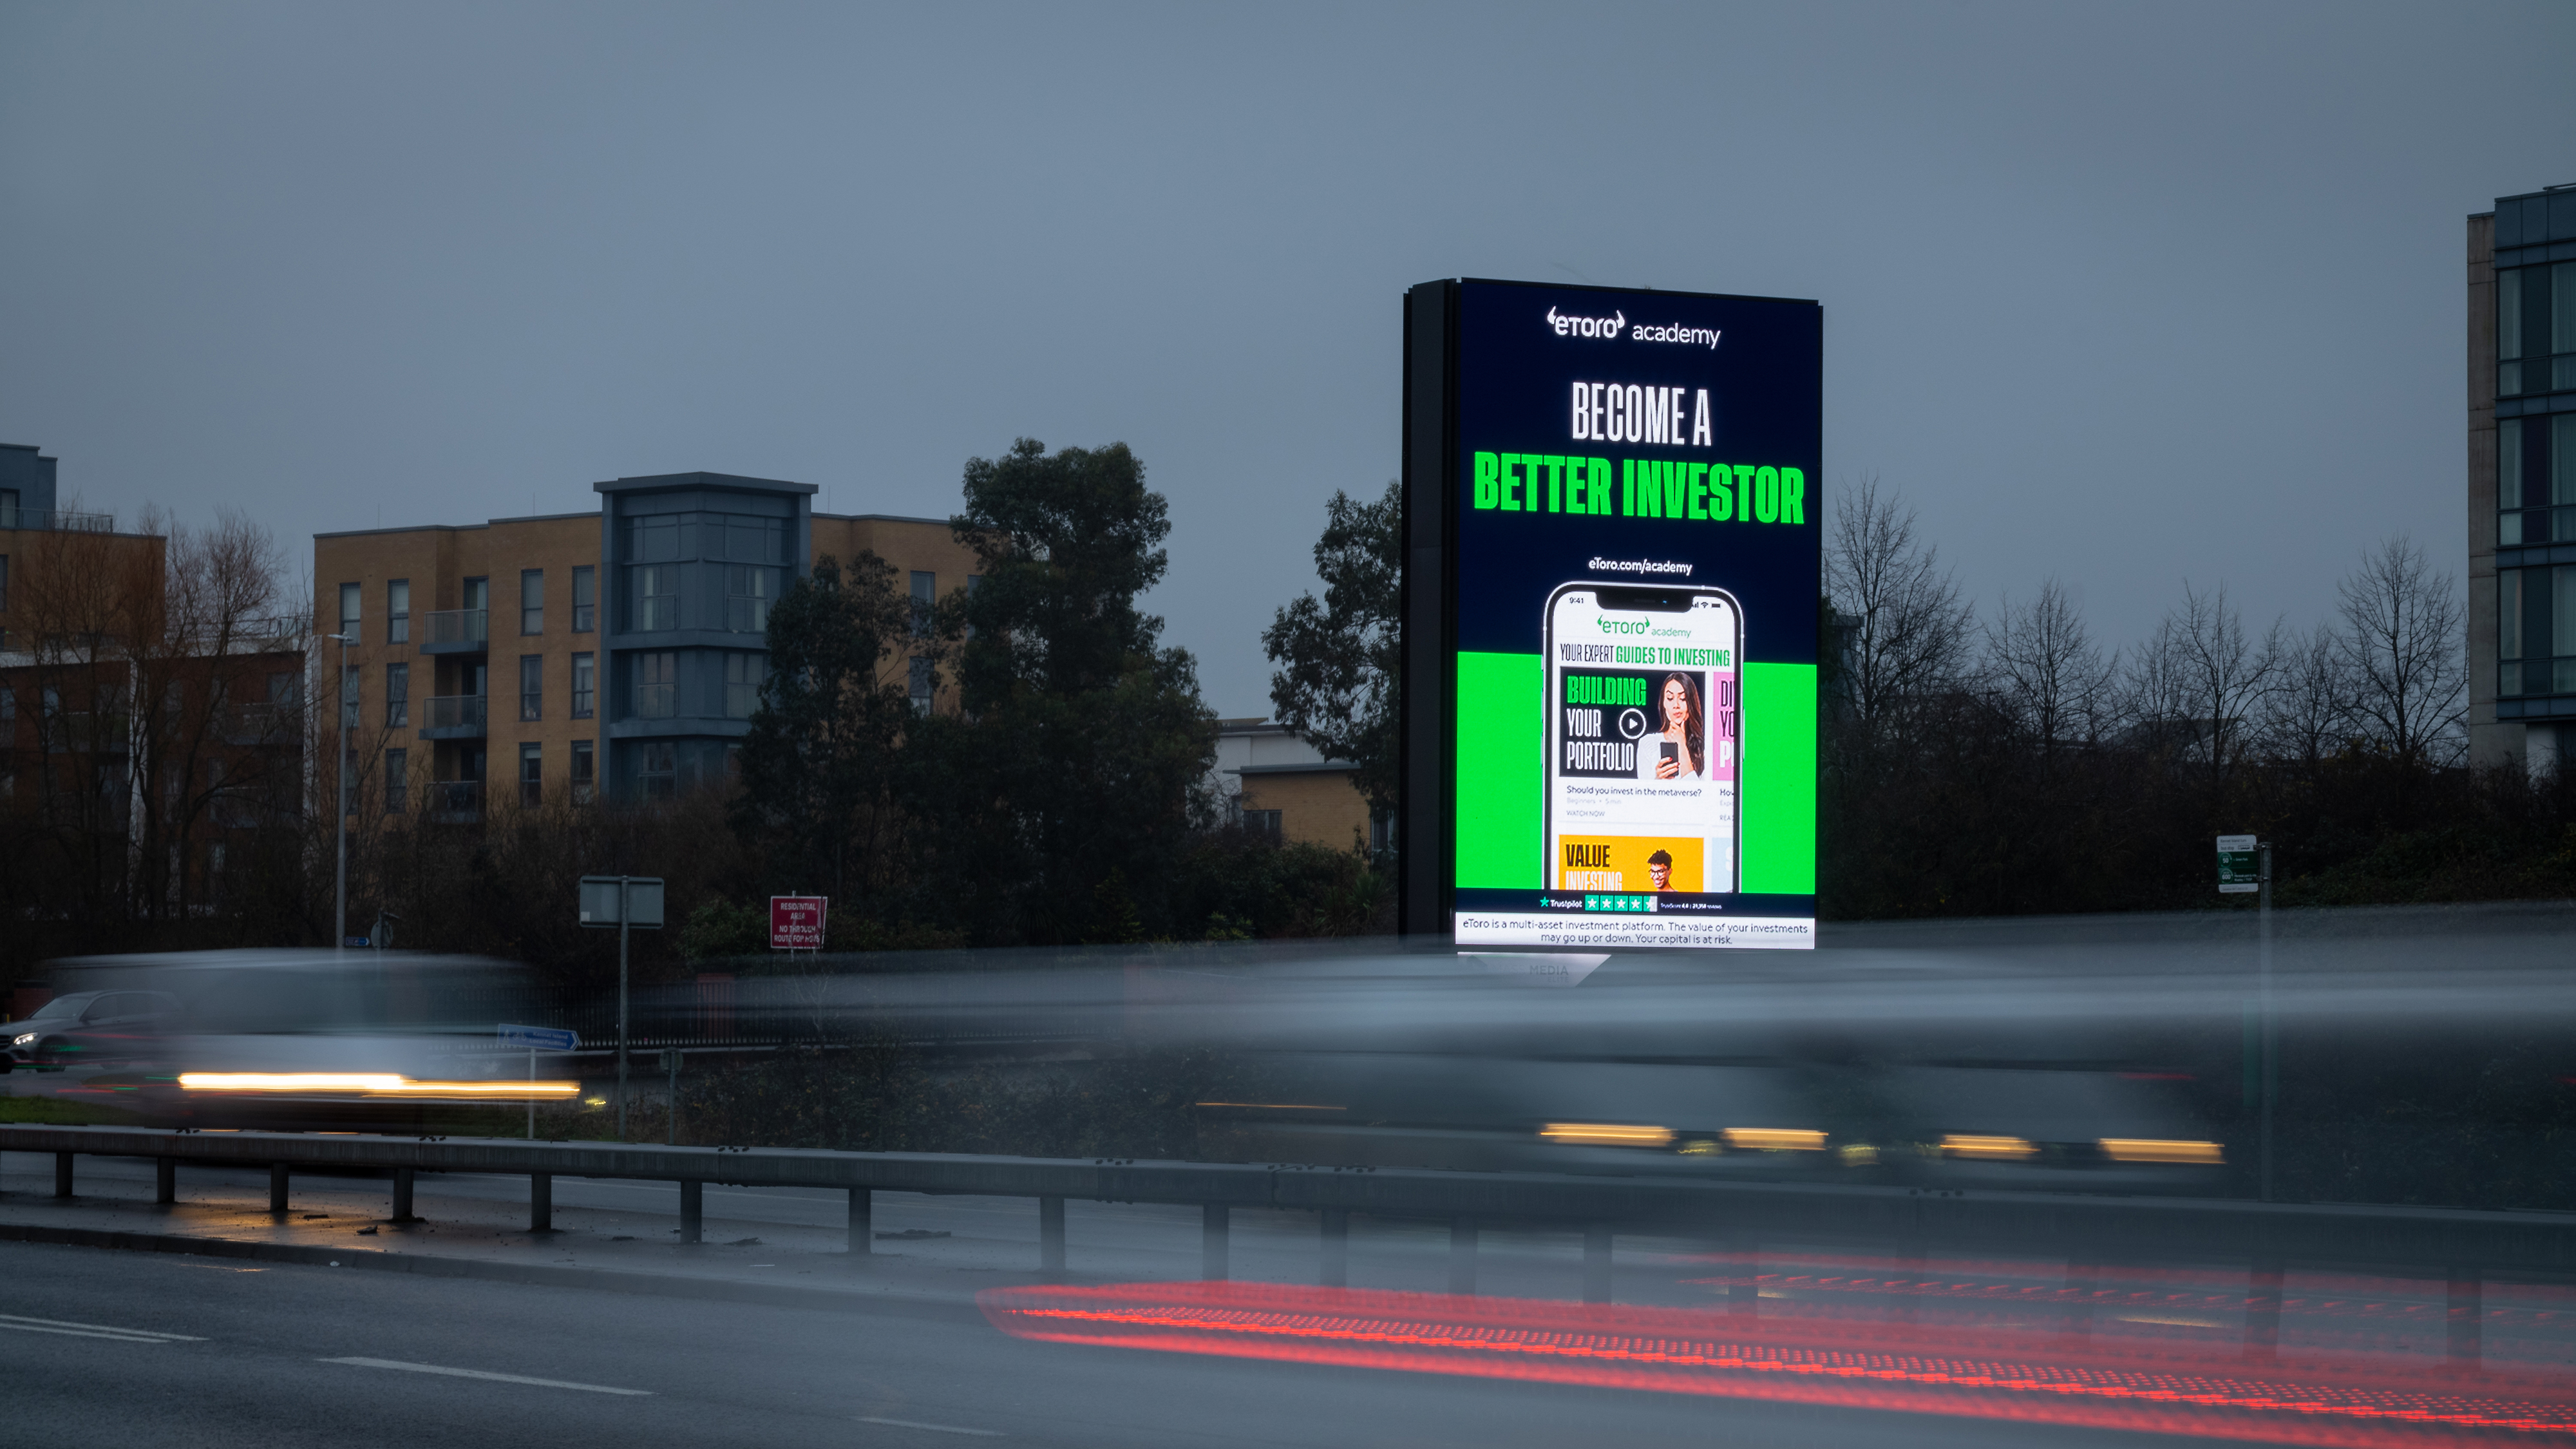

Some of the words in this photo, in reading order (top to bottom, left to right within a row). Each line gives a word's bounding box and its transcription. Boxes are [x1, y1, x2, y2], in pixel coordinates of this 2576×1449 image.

[1633, 323, 1721, 349] academy
[1573, 382, 1685, 445] BECOME
[1692, 389, 1711, 446] A
[1474, 451, 1612, 515] BETTER
[1623, 459, 1804, 524] INVESTOR
[1588, 557, 1692, 576] eToro.com/academy
[1651, 627, 1691, 638] academy
[1560, 644, 1582, 661] YOUR
[1584, 645, 1615, 663] EXPERT
[1616, 646, 1655, 664] GUIDES
[1658, 648, 1671, 665] TO
[1674, 648, 1730, 667] INVESTING
[1567, 676, 1646, 706] BUILDING
[1566, 708, 1602, 737] YOUR
[1567, 741, 1634, 771] PORTFOLIO
[1567, 785, 1594, 795] Should
[1595, 787, 1609, 795] you
[1611, 787, 1634, 795] invest
[1635, 787, 1642, 795] in
[1643, 788, 1657, 796] the
[1658, 788, 1702, 797] metaverse?
[1566, 844, 1611, 867] VALUE
[1566, 870, 1623, 891] INVESTING
[1550, 900, 1583, 909] Trustpilot
[1463, 919, 1490, 928] eToro
[1492, 919, 1499, 928] is
[1510, 920, 1563, 929] multi-asset
[1566, 921, 1618, 931] investment
[1622, 922, 1665, 932] platform.
[1669, 922, 1686, 931] The
[1688, 923, 1713, 932] value
[1715, 923, 1725, 932] of
[1727, 924, 1748, 934] your
[1750, 923, 1808, 934] investments
[1541, 934, 1560, 943] may
[1563, 935, 1576, 943] go
[1578, 935, 1591, 943] up
[1605, 934, 1634, 943] down.
[1636, 934, 1656, 943] Your
[1659, 934, 1690, 945] capital
[1693, 935, 1700, 944] is
[1703, 936, 1712, 944] at
[1714, 935, 1732, 945] risk.
[1530, 965, 1569, 975] MEDIA
